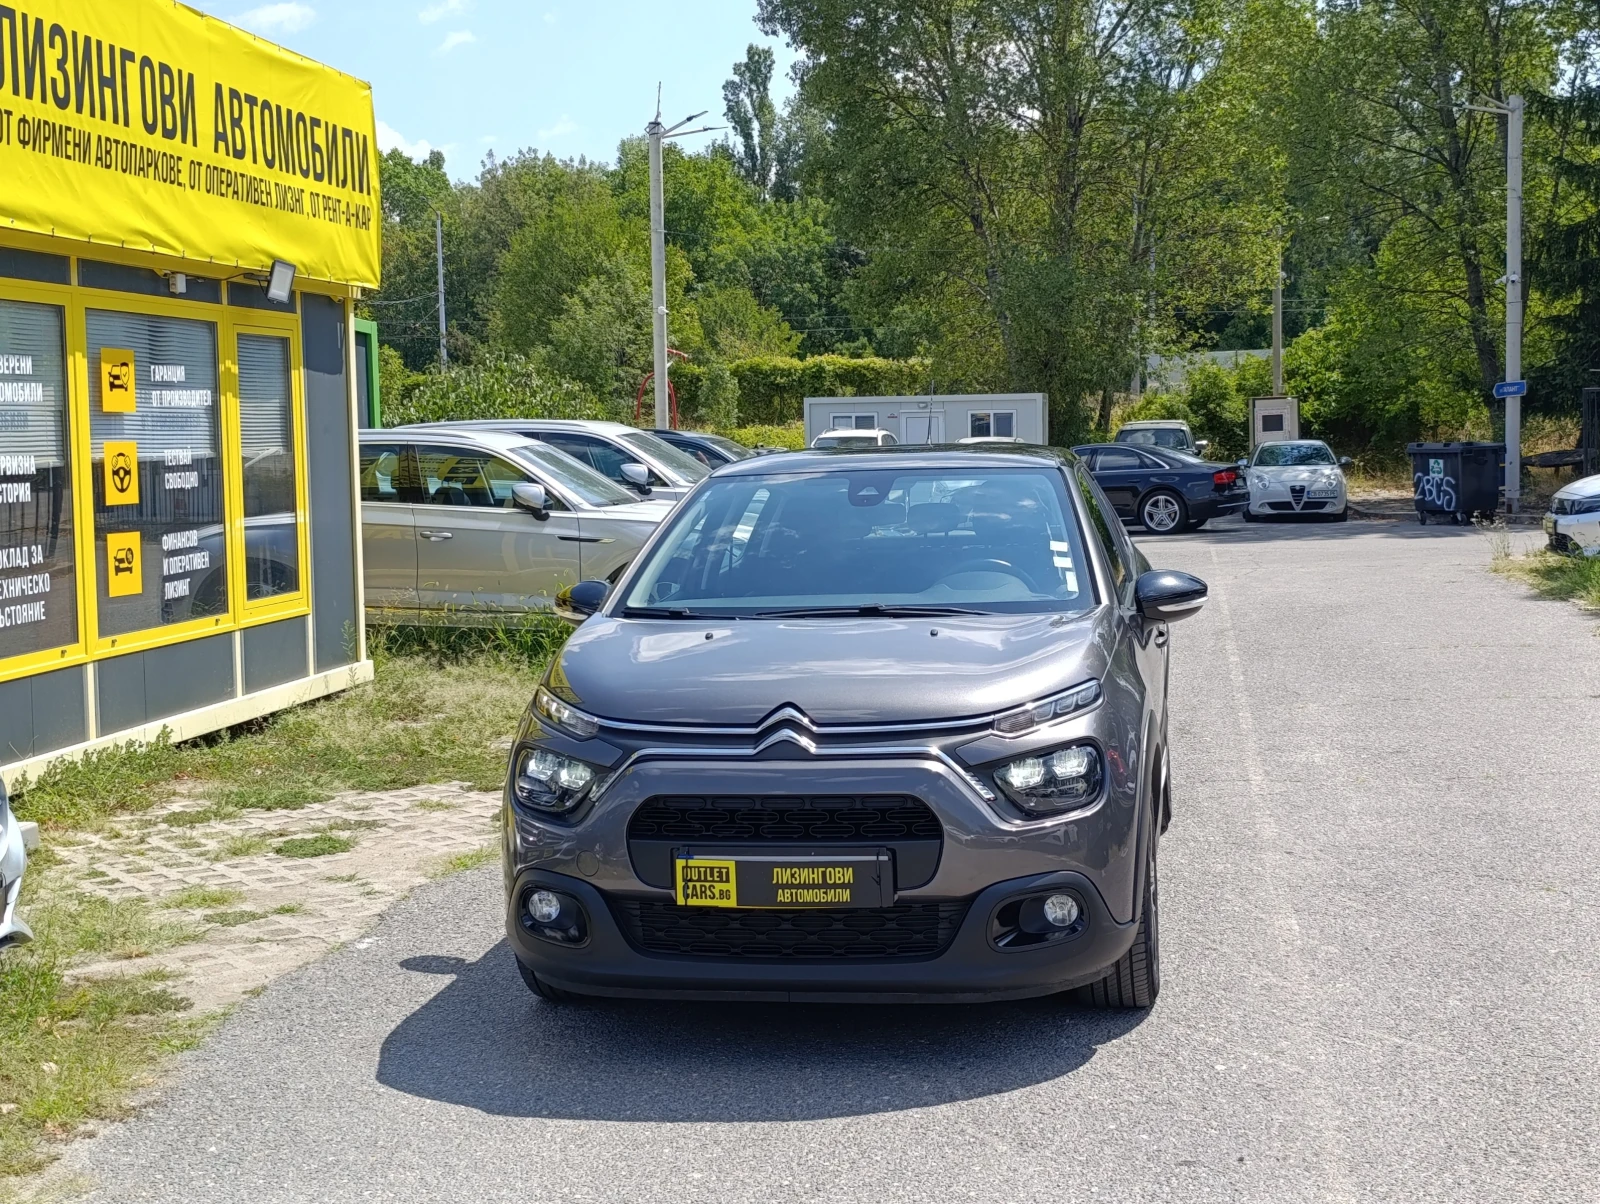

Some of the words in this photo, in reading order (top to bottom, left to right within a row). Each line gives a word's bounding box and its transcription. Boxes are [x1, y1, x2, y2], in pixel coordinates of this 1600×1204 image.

[0, 4, 198, 148] ЛИЗИНГОВИ
[214, 82, 371, 196] АВТОМОБИЛИ
[17, 114, 92, 165] ФИРМЕНИ
[95, 134, 186, 192] АВТОПАРКОВЕ,
[189, 159, 203, 193] ОТ
[205, 164, 272, 208] ОПЕРАТИВЕН
[322, 194, 371, 231] РЕНТ-А-КАР
[150, 365, 186, 384] ГАРАНЦИЯ
[152, 390, 161, 407] ОТ
[161, 389, 212, 407] ПРОИЗВОДИТЕЛ
[164, 446, 192, 466] ТЕСТВАЙ
[164, 471, 199, 490] СВОБОДНО
[162, 530, 198, 552] ФИНАНСОВ
[31, 544, 43, 565] ЗА
[163, 557, 169, 576] И
[169, 551, 210, 575] ОПЕРАТИВЕН
[164, 578, 191, 600] ЛИЗИНГ
[683, 867, 728, 881] OUTLET
[772, 867, 854, 885] ЛИЗИНГОВИ
[682, 883, 731, 901] CARS.BG
[777, 888, 851, 903] АВТОМОБИЛИ
